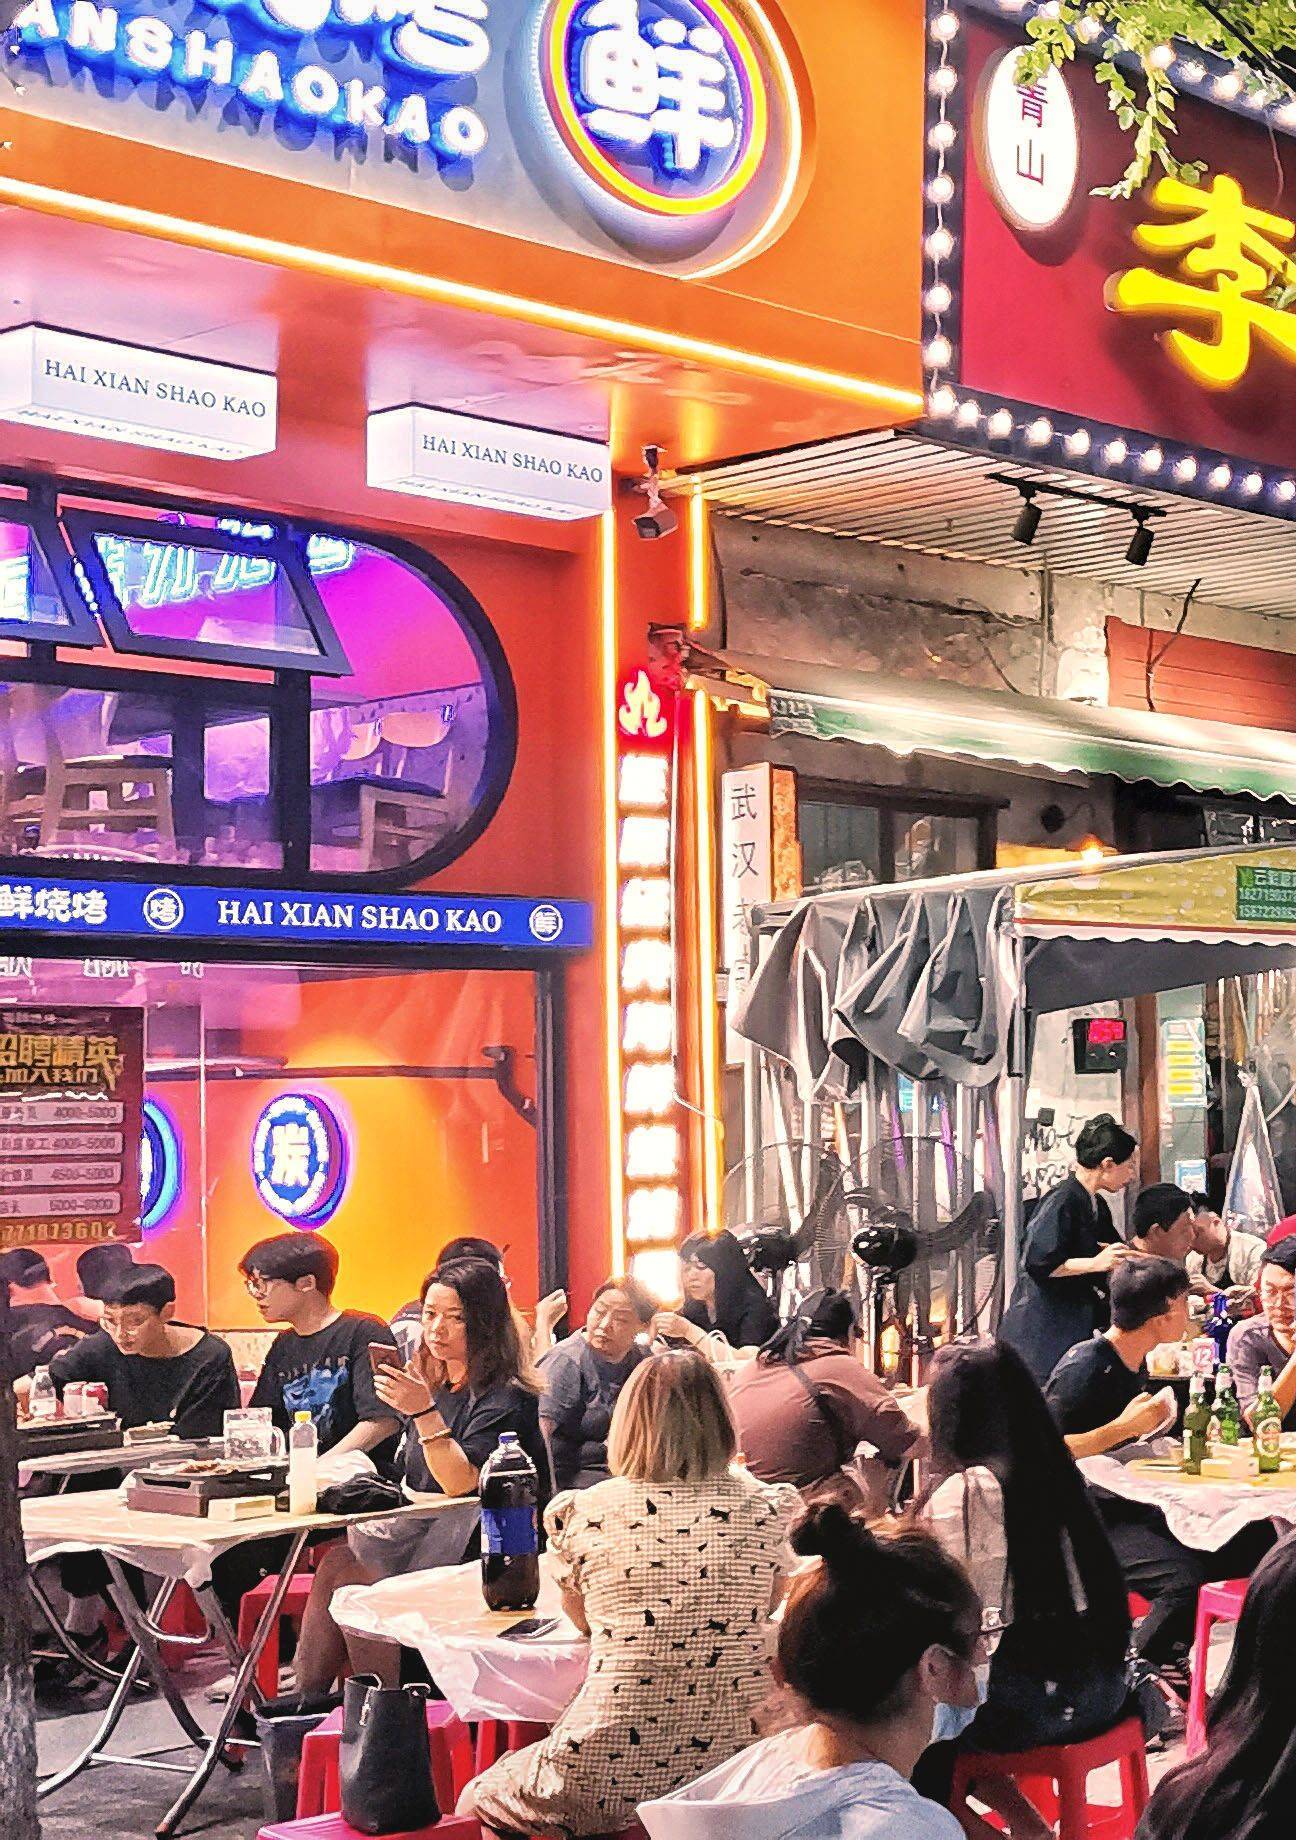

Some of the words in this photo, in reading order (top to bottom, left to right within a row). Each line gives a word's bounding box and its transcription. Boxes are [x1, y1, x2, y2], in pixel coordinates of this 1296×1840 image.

[578, 0, 738, 170] 鲜
[44, 358, 87, 384] HAI
[93, 368, 150, 396] XIAN
[155, 382, 217, 409] SHAO
[222, 394, 267, 418] KAO
[422, 434, 456, 456] HAI
[462, 441, 508, 465] XIAN
[512, 452, 562, 476] SHAO
[567, 463, 604, 484] KAO
[217, 900, 274, 926] HAI
[280, 902, 354, 929] XIAN
[360, 905, 440, 932] SHAO
[445, 909, 502, 933] KAO
